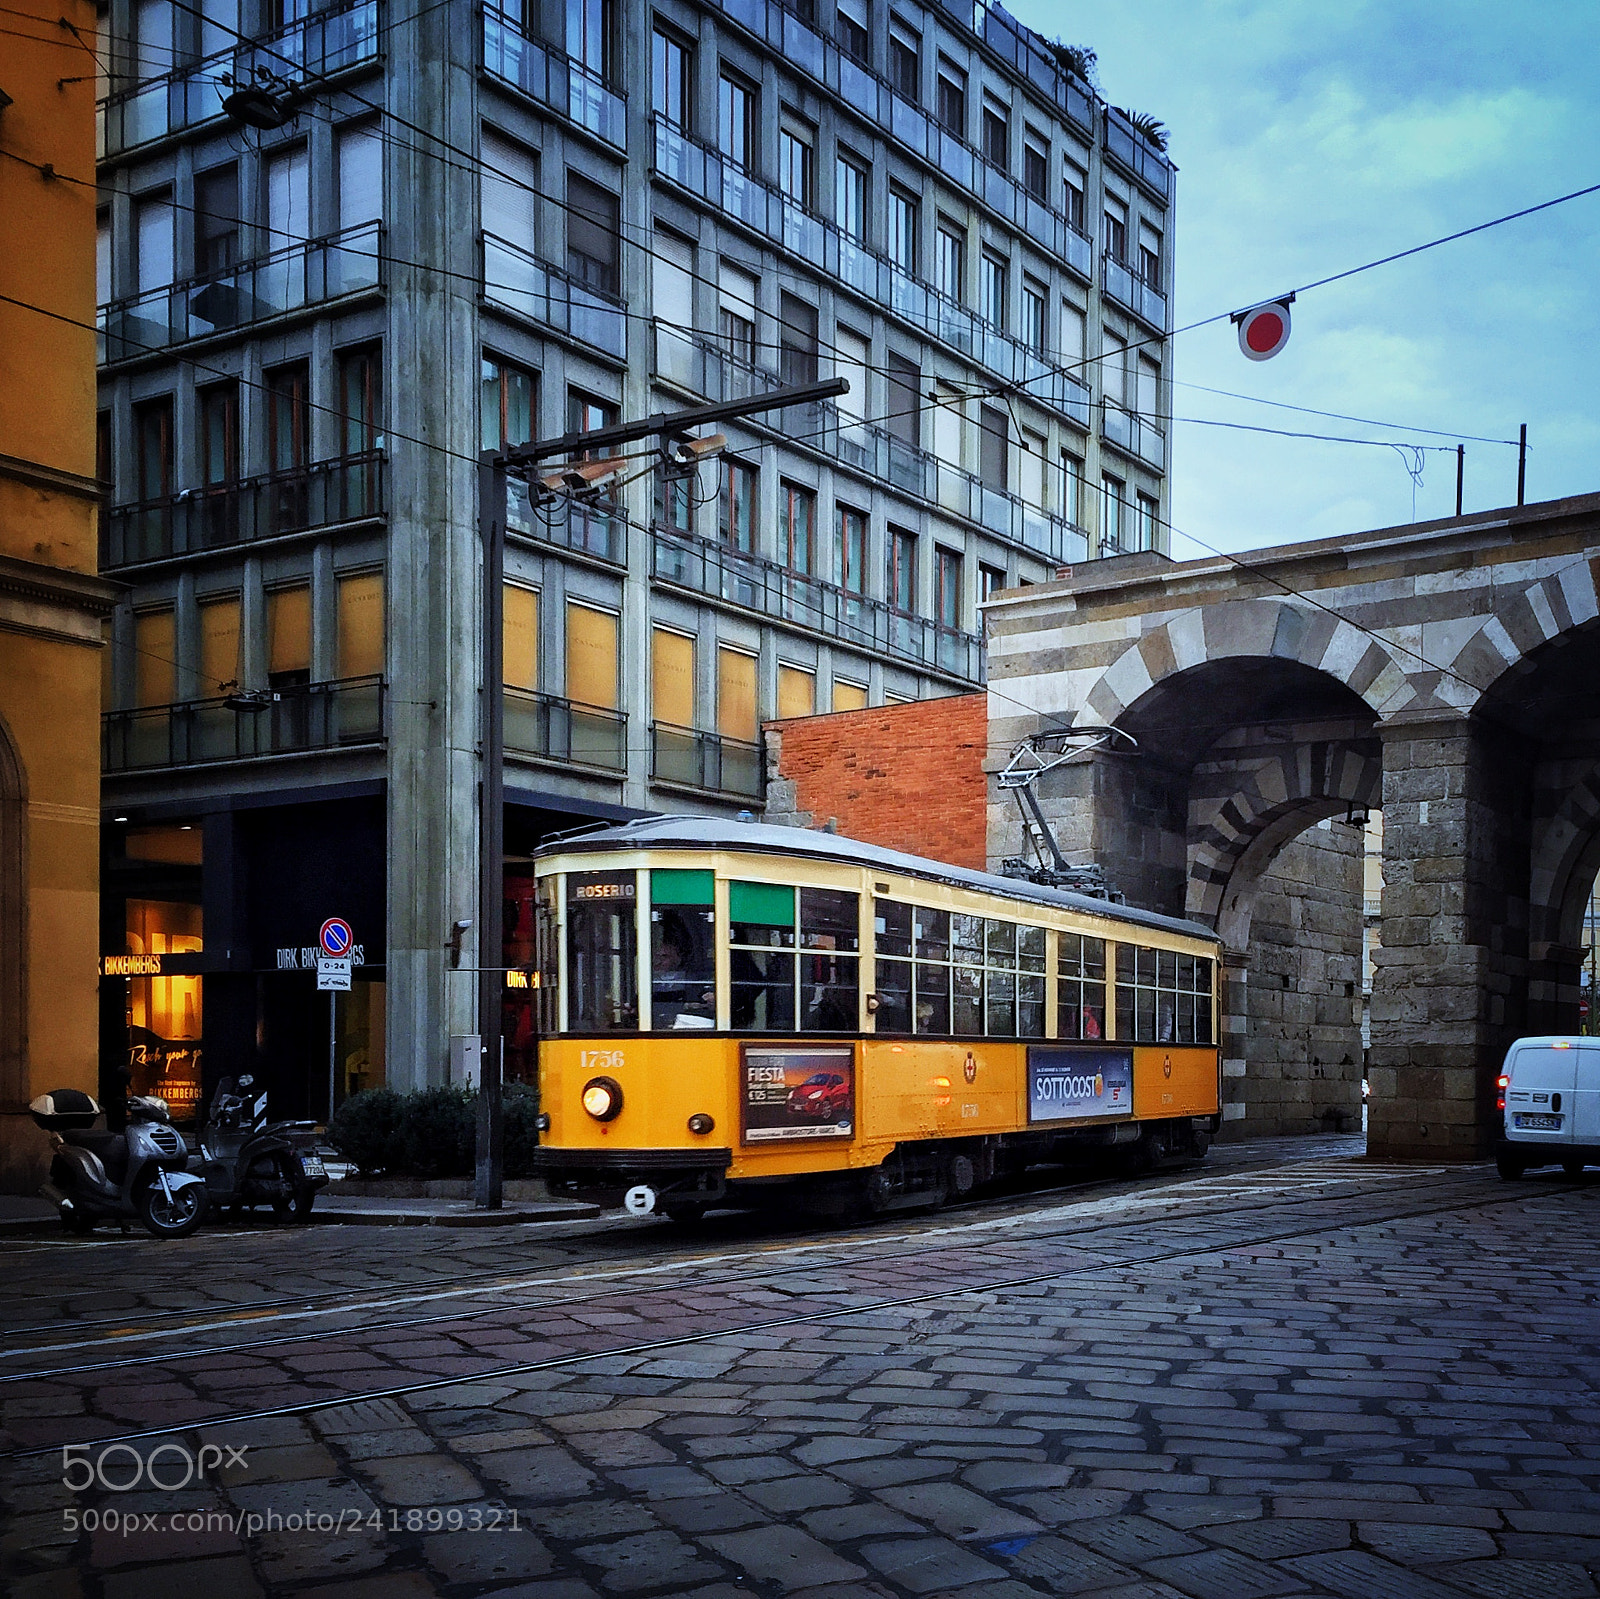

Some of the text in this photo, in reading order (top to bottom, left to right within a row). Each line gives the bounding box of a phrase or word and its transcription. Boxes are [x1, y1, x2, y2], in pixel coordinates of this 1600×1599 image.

[576, 884, 635, 898] ROSERIO
[104, 954, 161, 976] BIKKEMBERGS
[276, 947, 298, 969] DIRK
[506, 970, 528, 989] DIRK
[580, 1050, 625, 1068] 1756
[747, 1067, 785, 1082] FIESTA
[149, 1087, 203, 1099] BIKKEMBERGS
